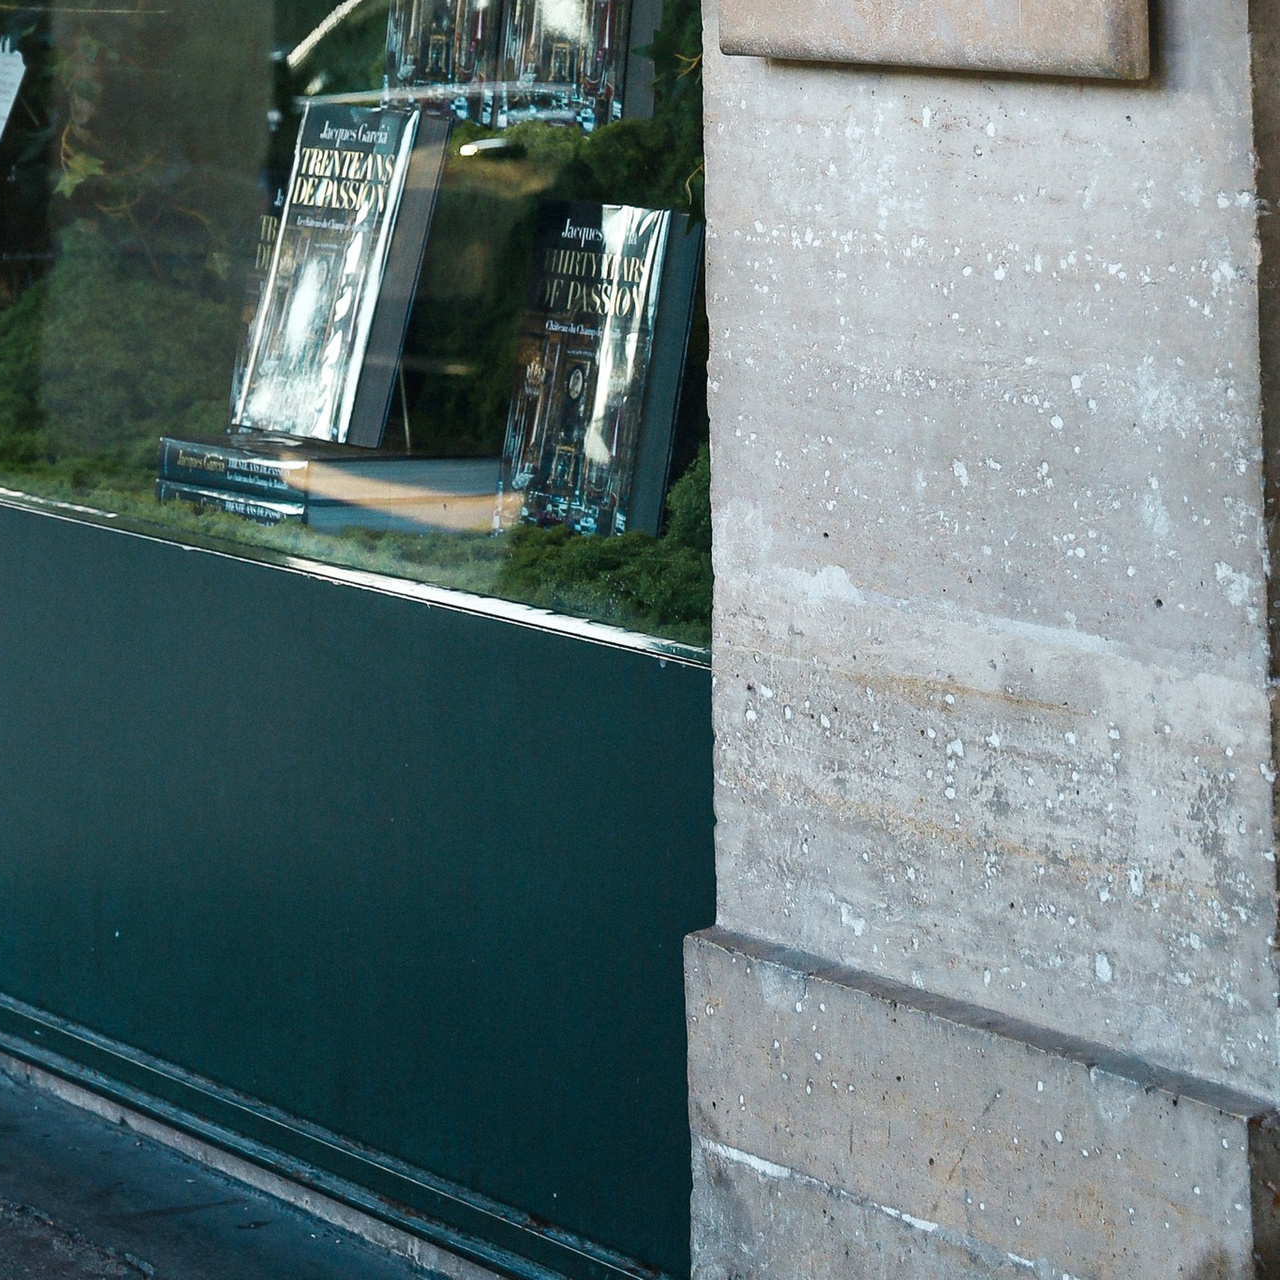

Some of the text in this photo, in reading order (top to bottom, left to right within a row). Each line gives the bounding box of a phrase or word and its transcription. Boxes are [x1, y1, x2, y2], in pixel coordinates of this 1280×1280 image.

[320, 121, 388, 148] Jacques Garcia
[301, 147, 395, 182] TRENTE ANS
[292, 176, 318, 207] DE
[318, 178, 389, 213] PASSION
[562, 219, 603, 248] Jacques
